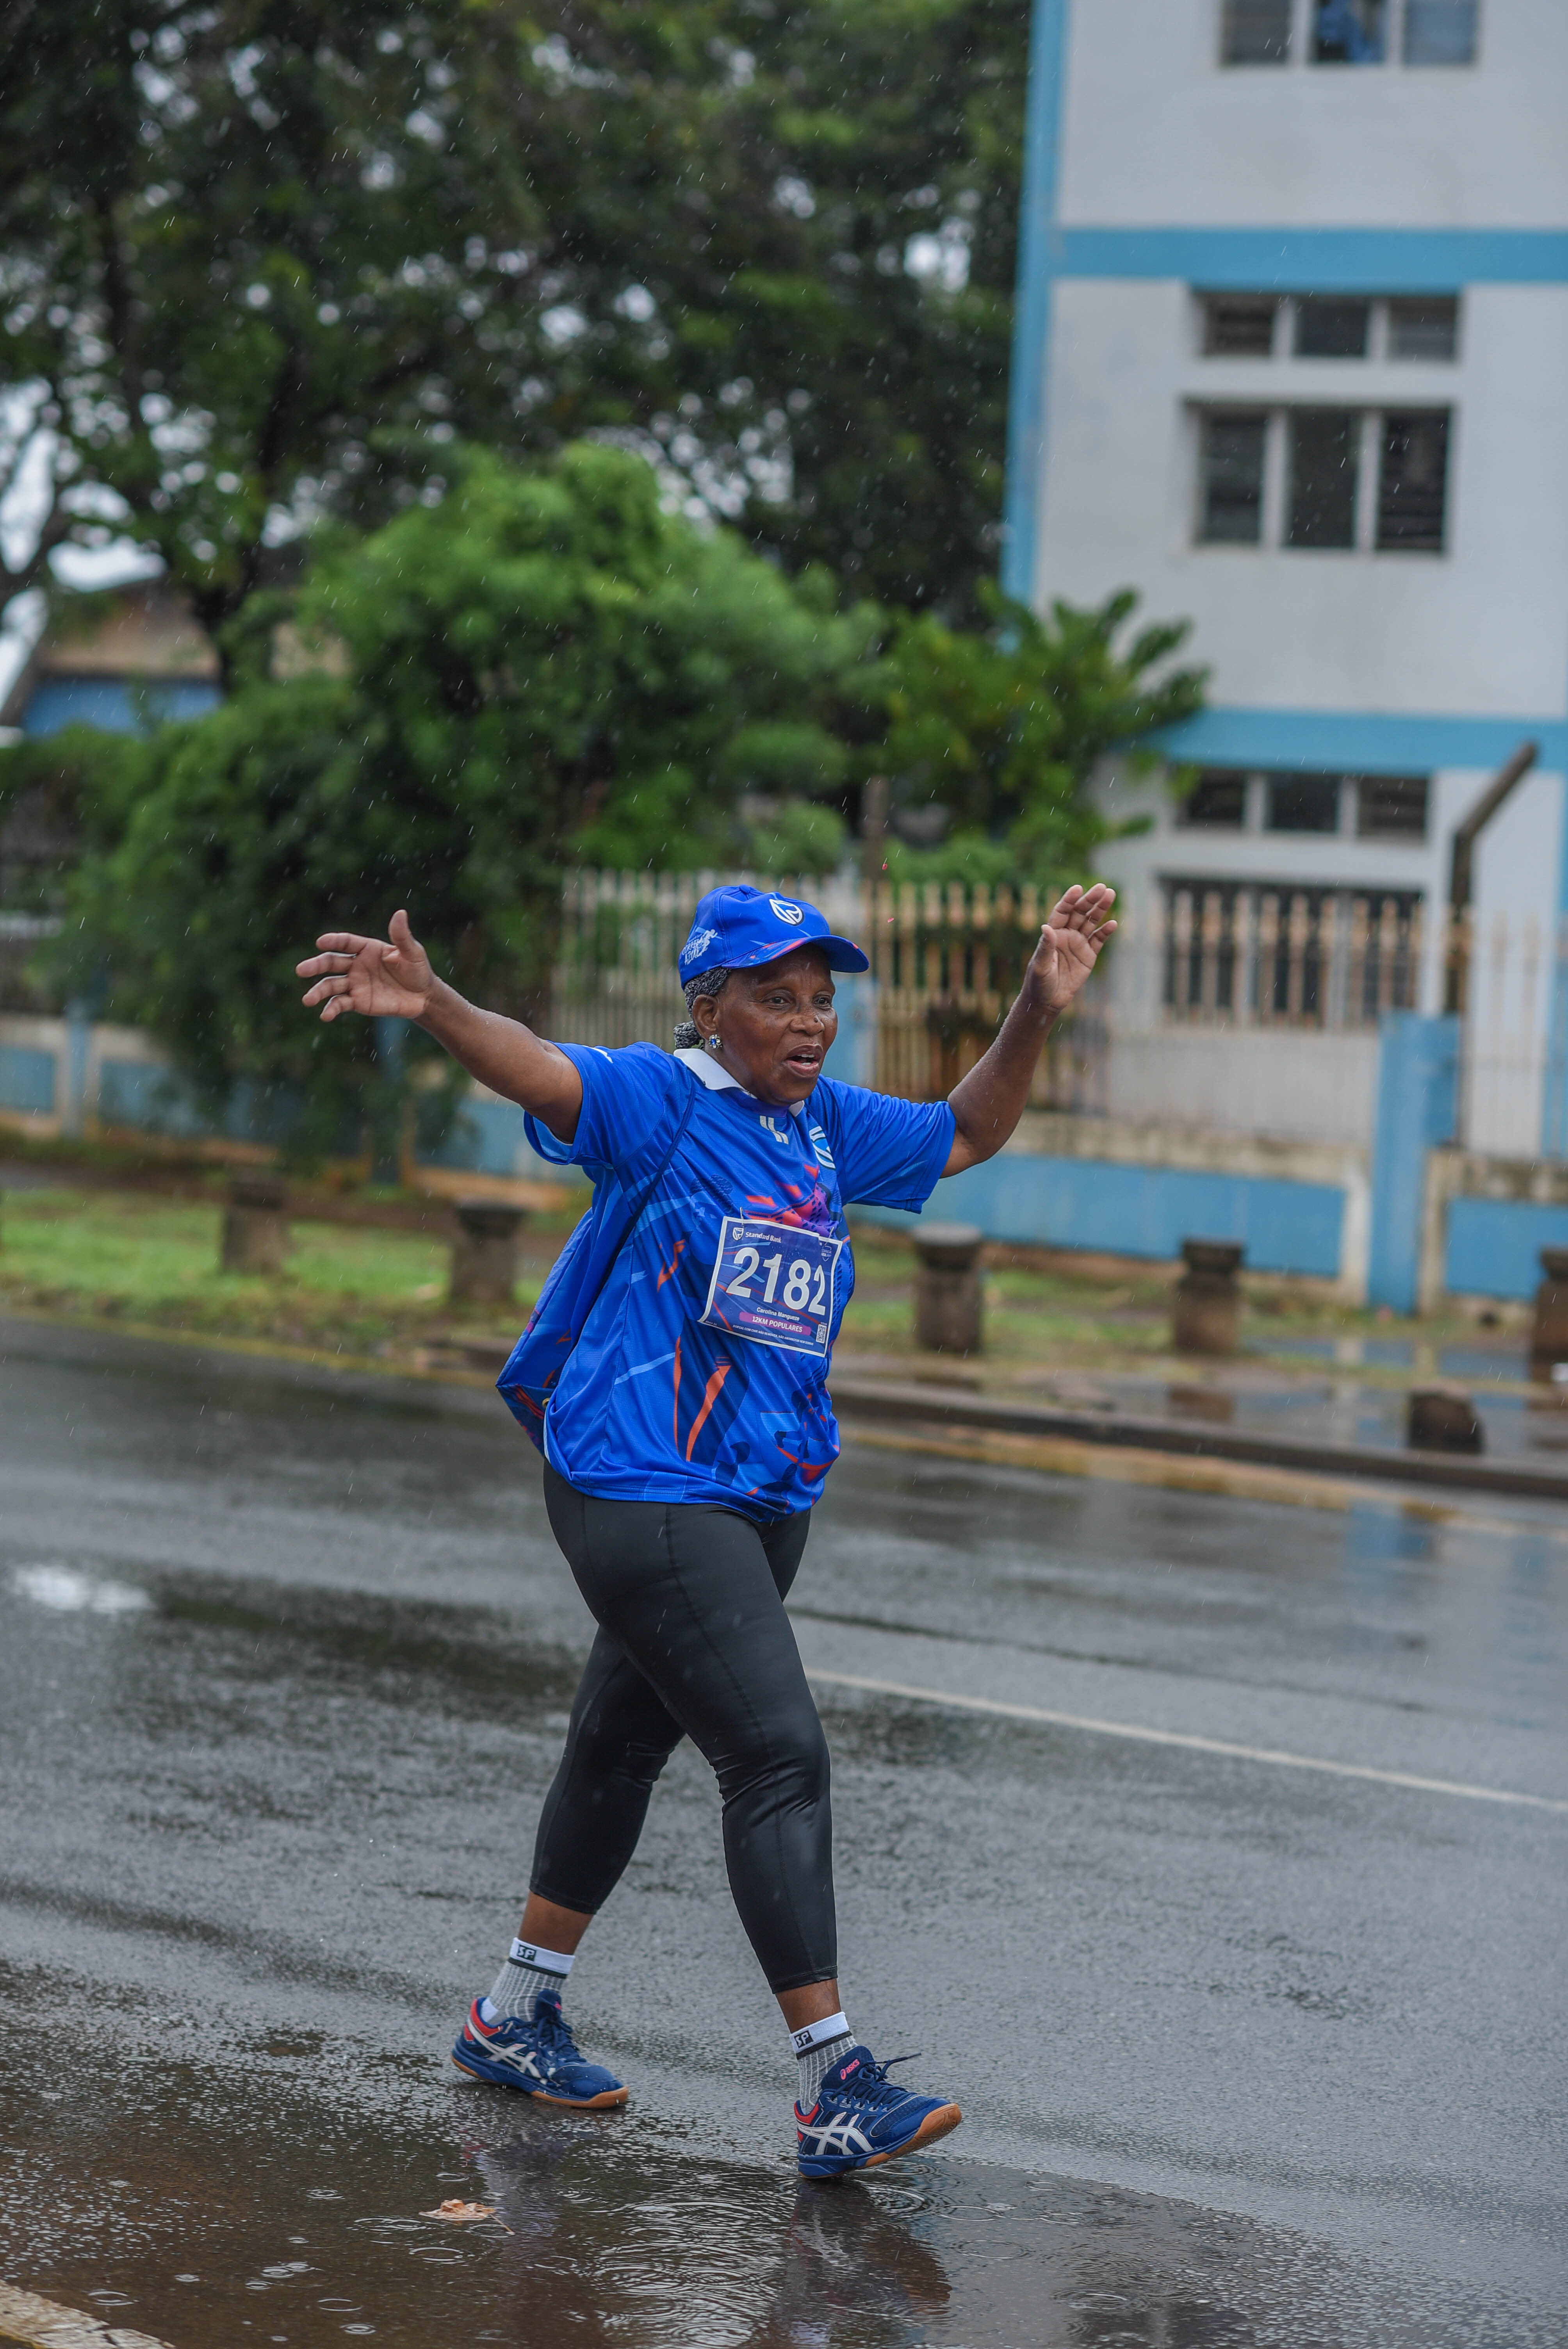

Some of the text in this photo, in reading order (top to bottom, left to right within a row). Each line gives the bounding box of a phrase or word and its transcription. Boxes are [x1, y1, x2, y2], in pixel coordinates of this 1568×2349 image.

[684, 950, 702, 965] AZUL
[745, 1232, 781, 1243] Standard Bank
[726, 1247, 825, 1316] 2182
[756, 1307, 777, 1316] Carolina
[752, 1316, 803, 1333] 12KM POPULARES
[519, 1946, 535, 1958] SP
[795, 2032, 809, 2047] SP
[846, 2058, 860, 2074] asics
